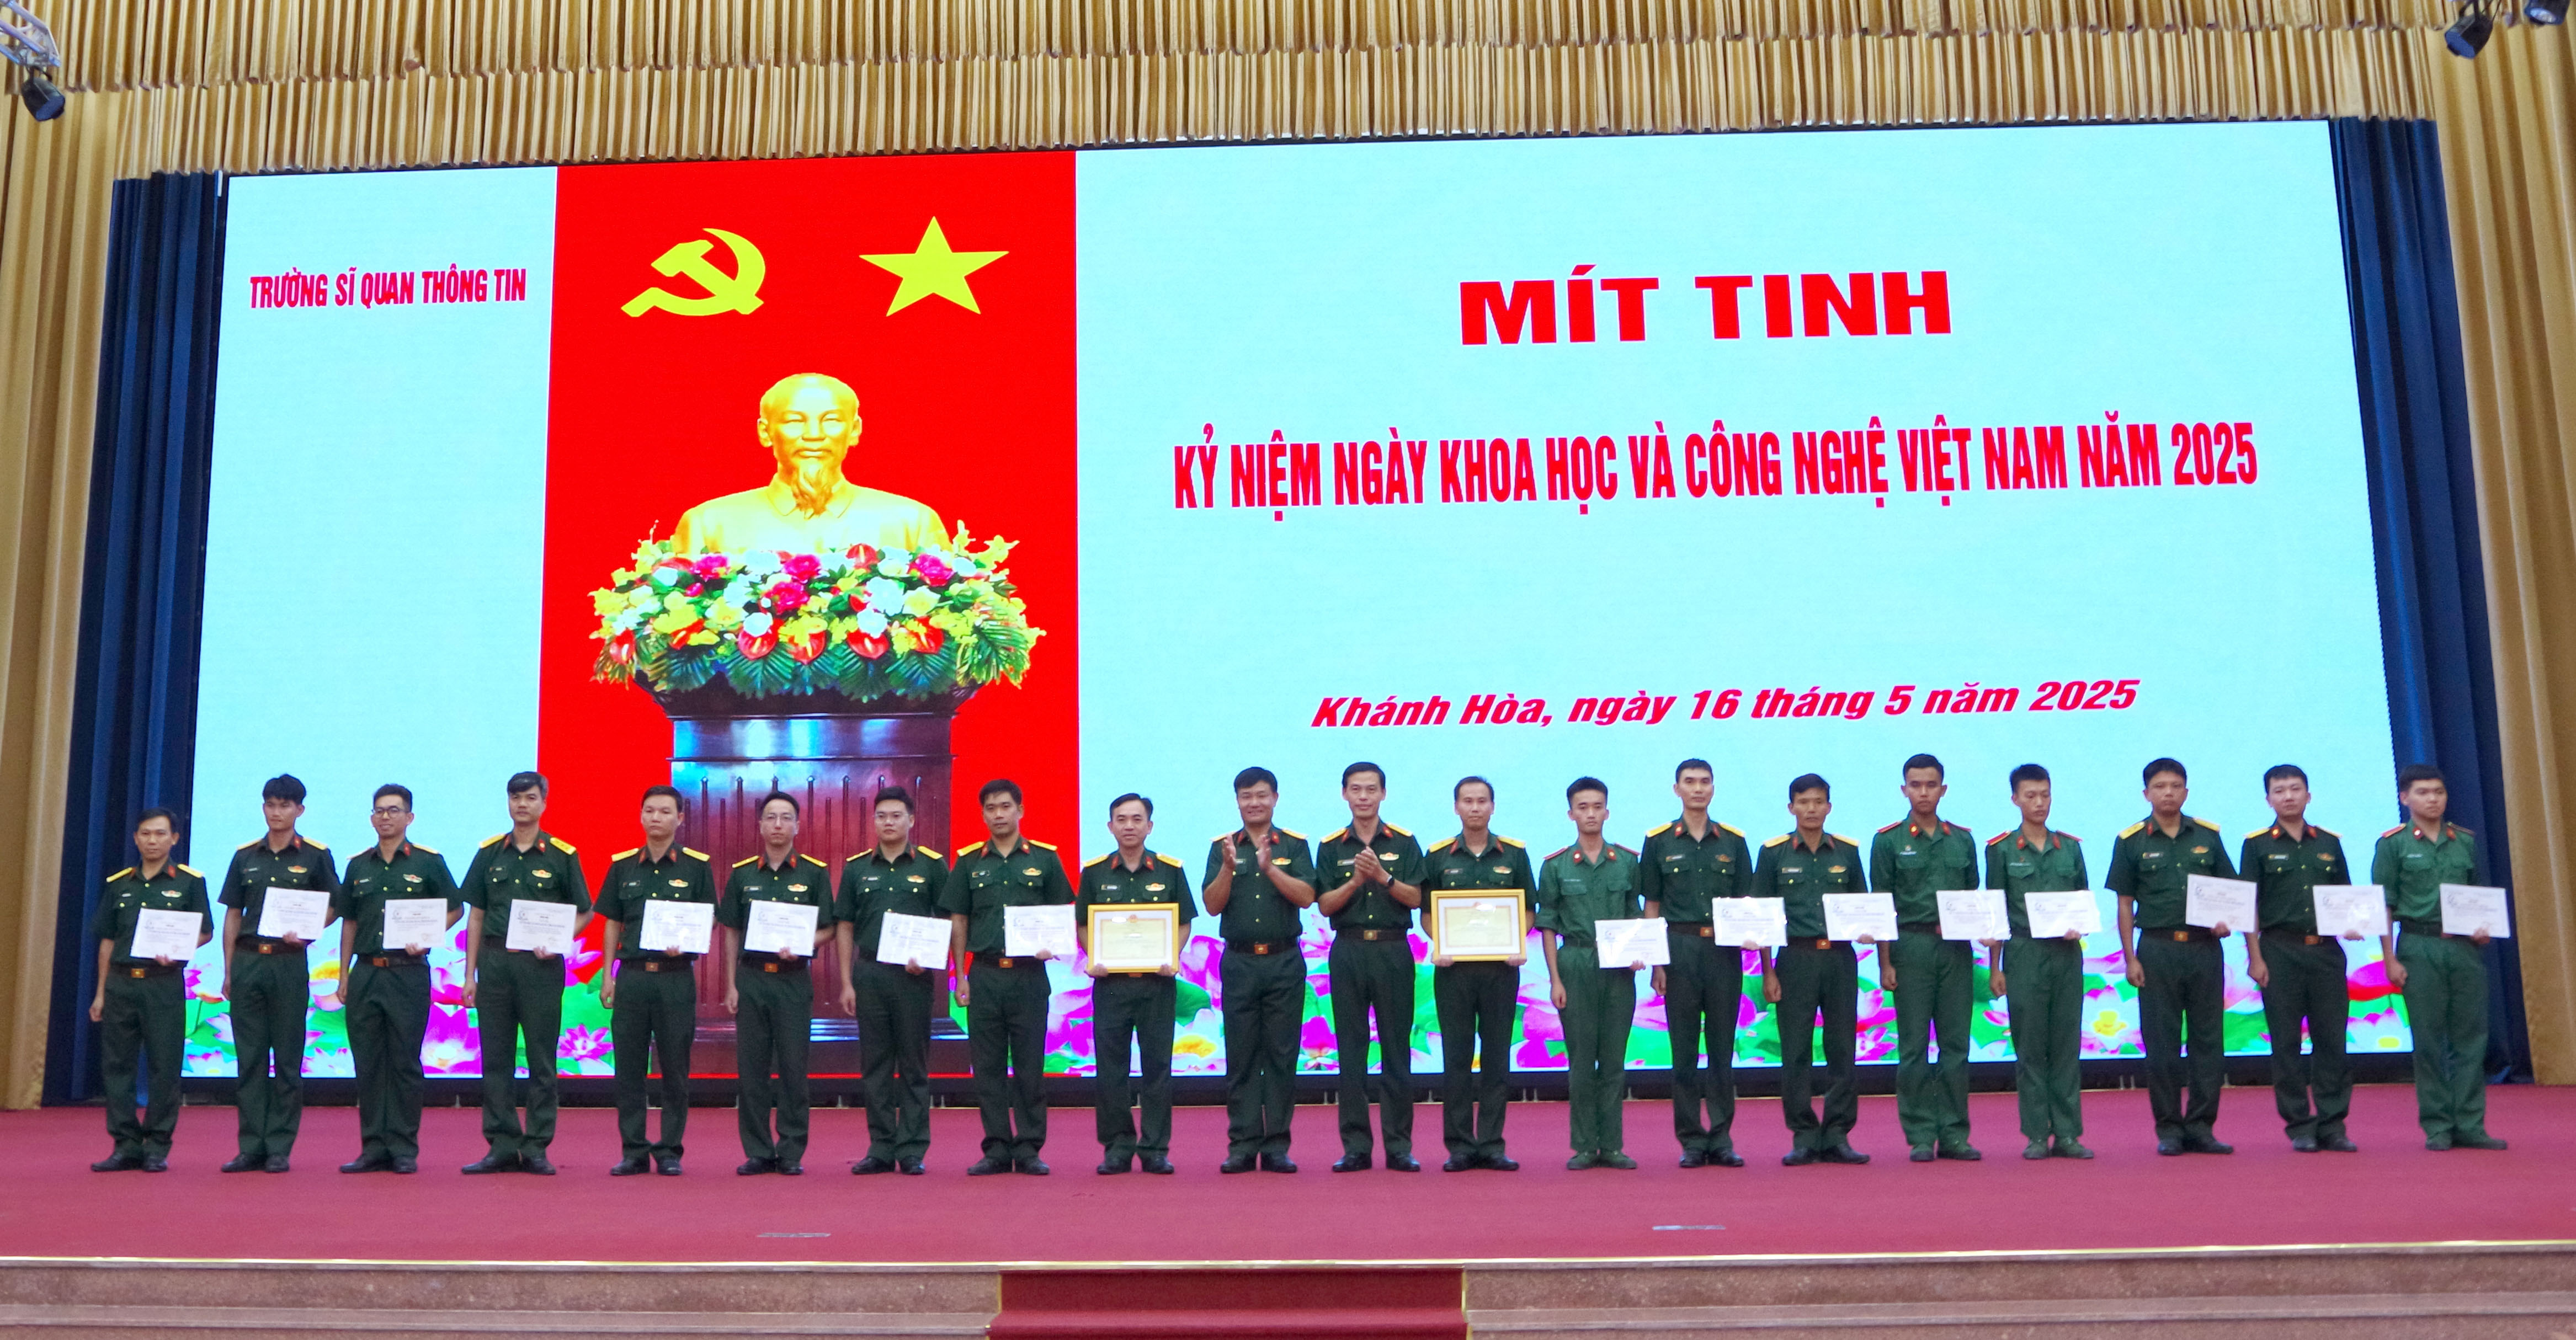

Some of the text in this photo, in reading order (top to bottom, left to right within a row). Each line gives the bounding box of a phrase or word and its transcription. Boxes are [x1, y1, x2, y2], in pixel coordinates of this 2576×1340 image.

[250, 263, 526, 309] TRƯỜNG SĨ QUAN THÔNG TIN
[1460, 264, 1951, 345] MÍT TINH
[1174, 410, 2258, 522] KỶ NIỆM NGÀY KHOA HỌC VÀ CÔNG NGHỆ VIỆT NAM NĂM 2025
[1311, 679, 2141, 727] Khánh Hòa, ngày 16 tháng 5 năm 2025
